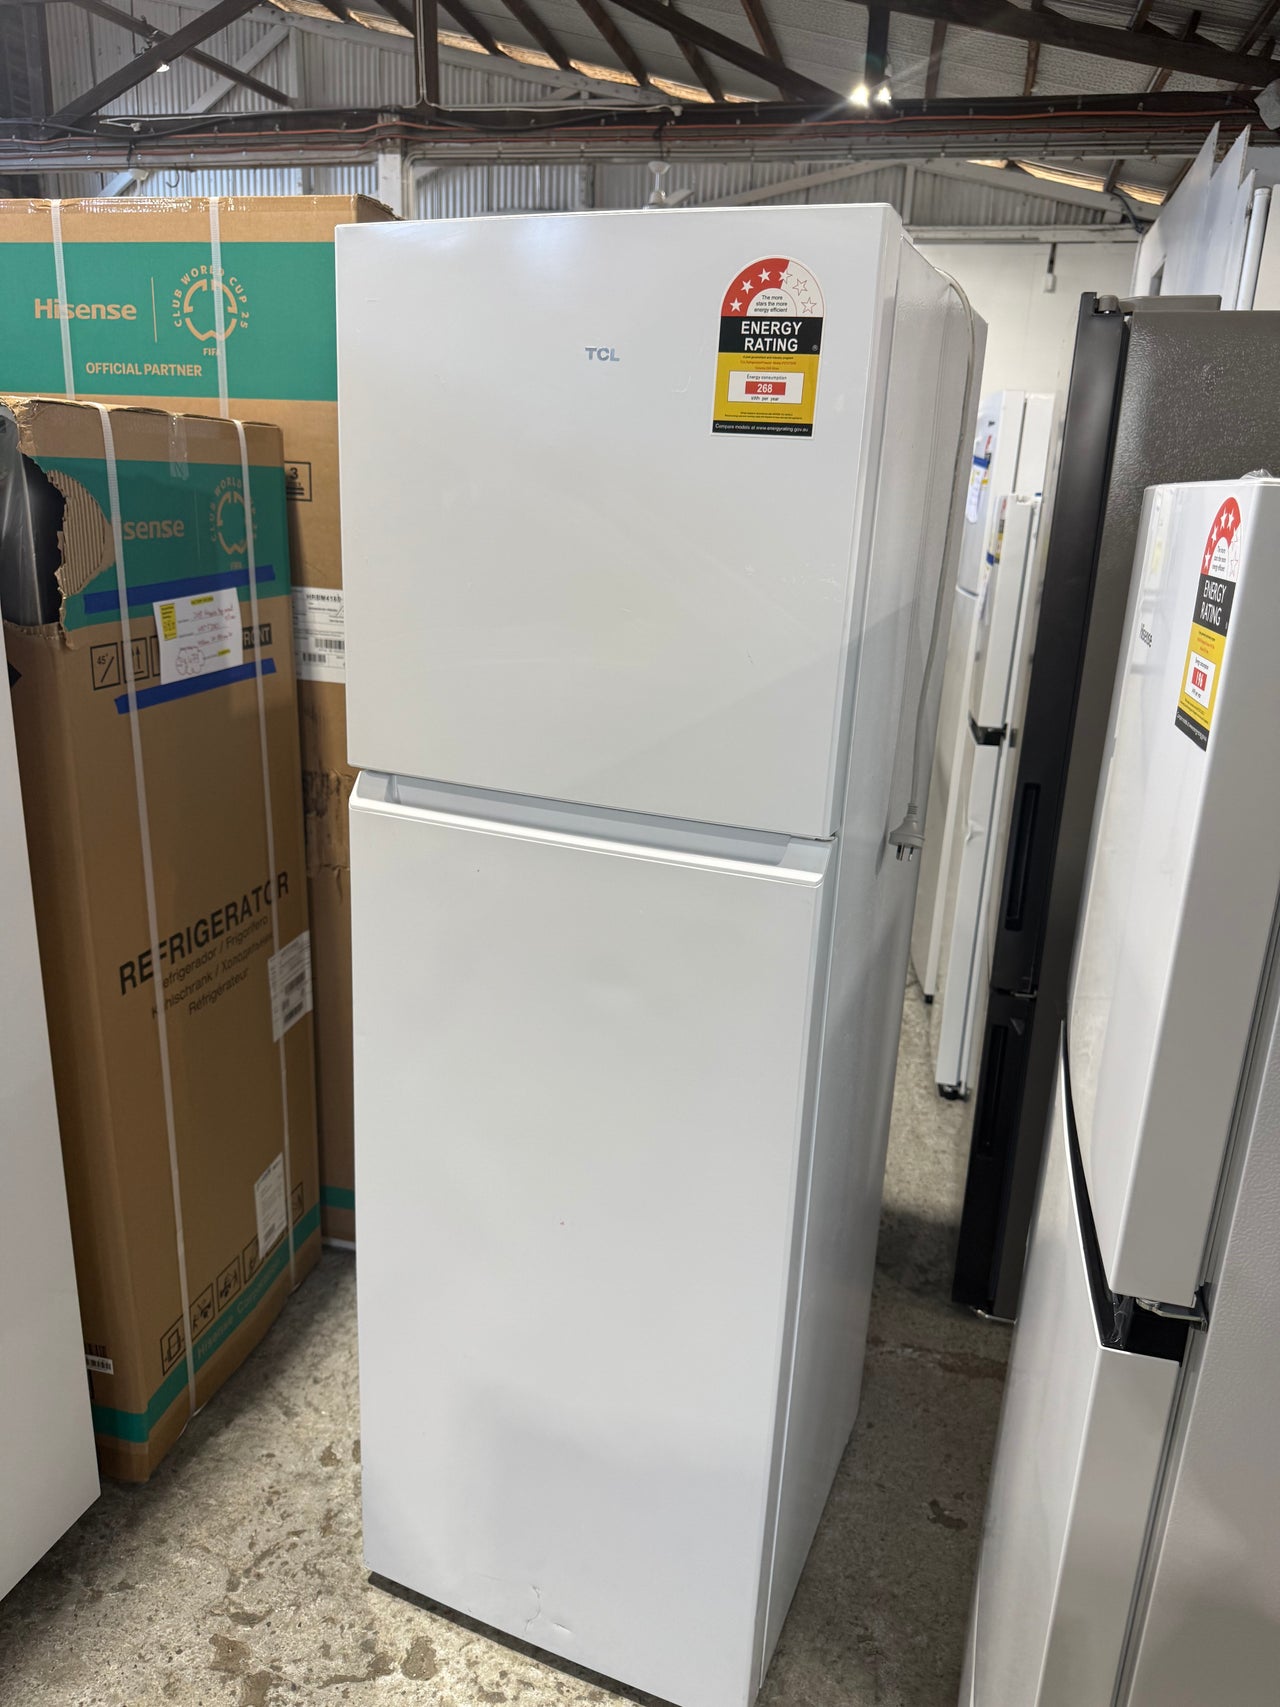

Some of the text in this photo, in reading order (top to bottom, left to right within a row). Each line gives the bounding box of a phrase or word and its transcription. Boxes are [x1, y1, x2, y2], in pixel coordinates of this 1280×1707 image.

[34, 298, 137, 320] Hisense
[172, 289, 182, 327] CLUB
[229, 277, 247, 303] CUP
[240, 312, 249, 328] 25
[741, 321, 802, 335] ENERGY
[585, 347, 620, 361] TCL
[744, 338, 798, 352] RATING
[85, 362, 202, 376] OFFICIAL PARTNER
[757, 384, 772, 393] 268
[123, 520, 184, 540] sense
[1203, 580, 1227, 603] ENERGY
[1200, 602, 1222, 626] RATING
[243, 627, 270, 646] RONT
[119, 871, 289, 996] REFRIGERATOR
[163, 946, 217, 988] efrigerador
